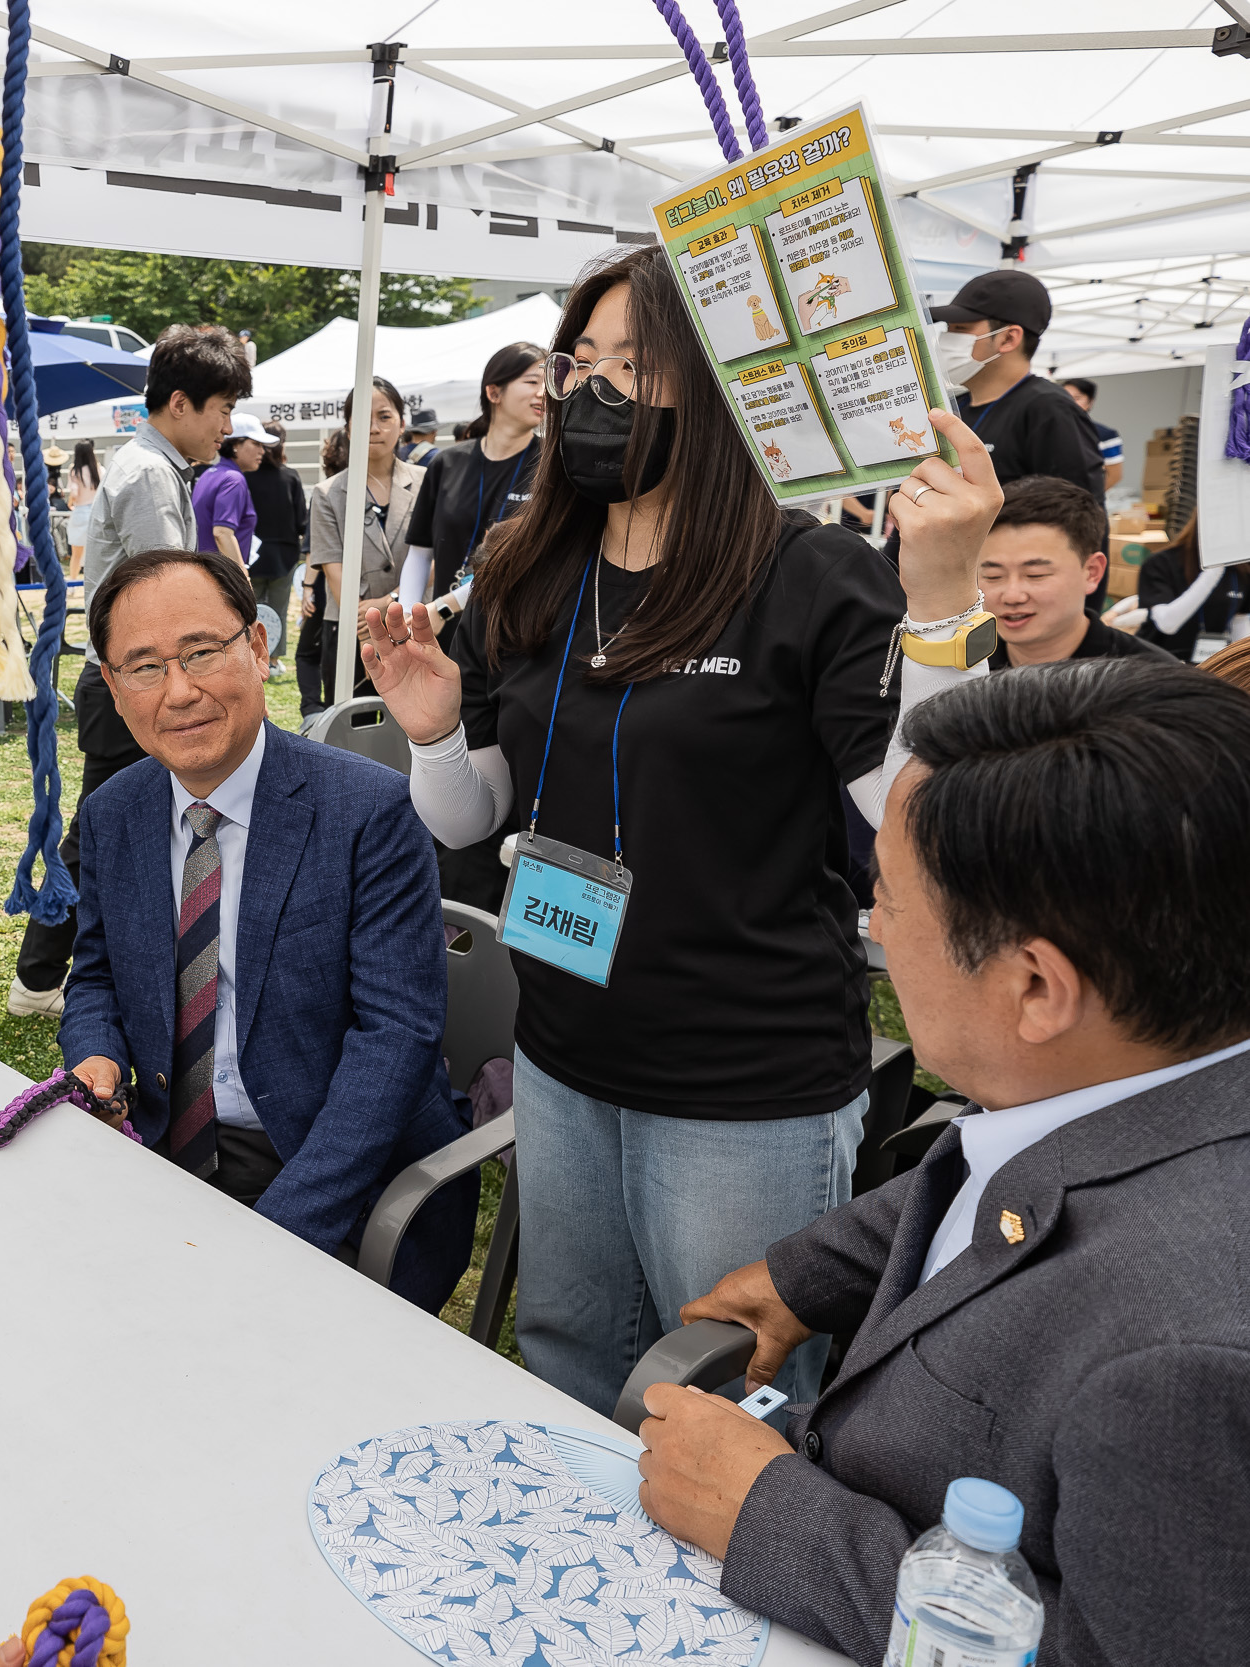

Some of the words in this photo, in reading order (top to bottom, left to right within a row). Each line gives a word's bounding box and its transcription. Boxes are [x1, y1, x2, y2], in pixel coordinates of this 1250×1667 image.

[665, 187, 727, 228] 터그놀이,
[727, 176, 747, 200] 왜
[746, 151, 800, 191] 필요한
[801, 126, 851, 166] 걸까?
[791, 194, 810, 210] 치석
[811, 184, 831, 201] 제거
[811, 207, 834, 221] 가지고
[697, 237, 711, 251] 교육
[712, 230, 728, 244] 효과
[781, 229, 808, 247] 과정에서
[832, 246, 839, 255] 수
[840, 236, 864, 252] 있어요!
[726, 261, 732, 269] 수
[841, 334, 868, 351] 주의점
[742, 368, 768, 382] 스트레스
[767, 363, 782, 373] 해소
[824, 364, 849, 378] 강아지가
[270, 403, 295, 421] 멍멍
[300, 401, 345, 420] 플리마
[68, 413, 78, 430] 수
[700, 656, 741, 676] MED
[522, 859, 544, 874] 부스팀
[581, 892, 602, 906] 로프토이
[602, 900, 619, 912] 만들기
[584, 882, 621, 904] 프로그램장
[523, 895, 599, 948] 김채림
